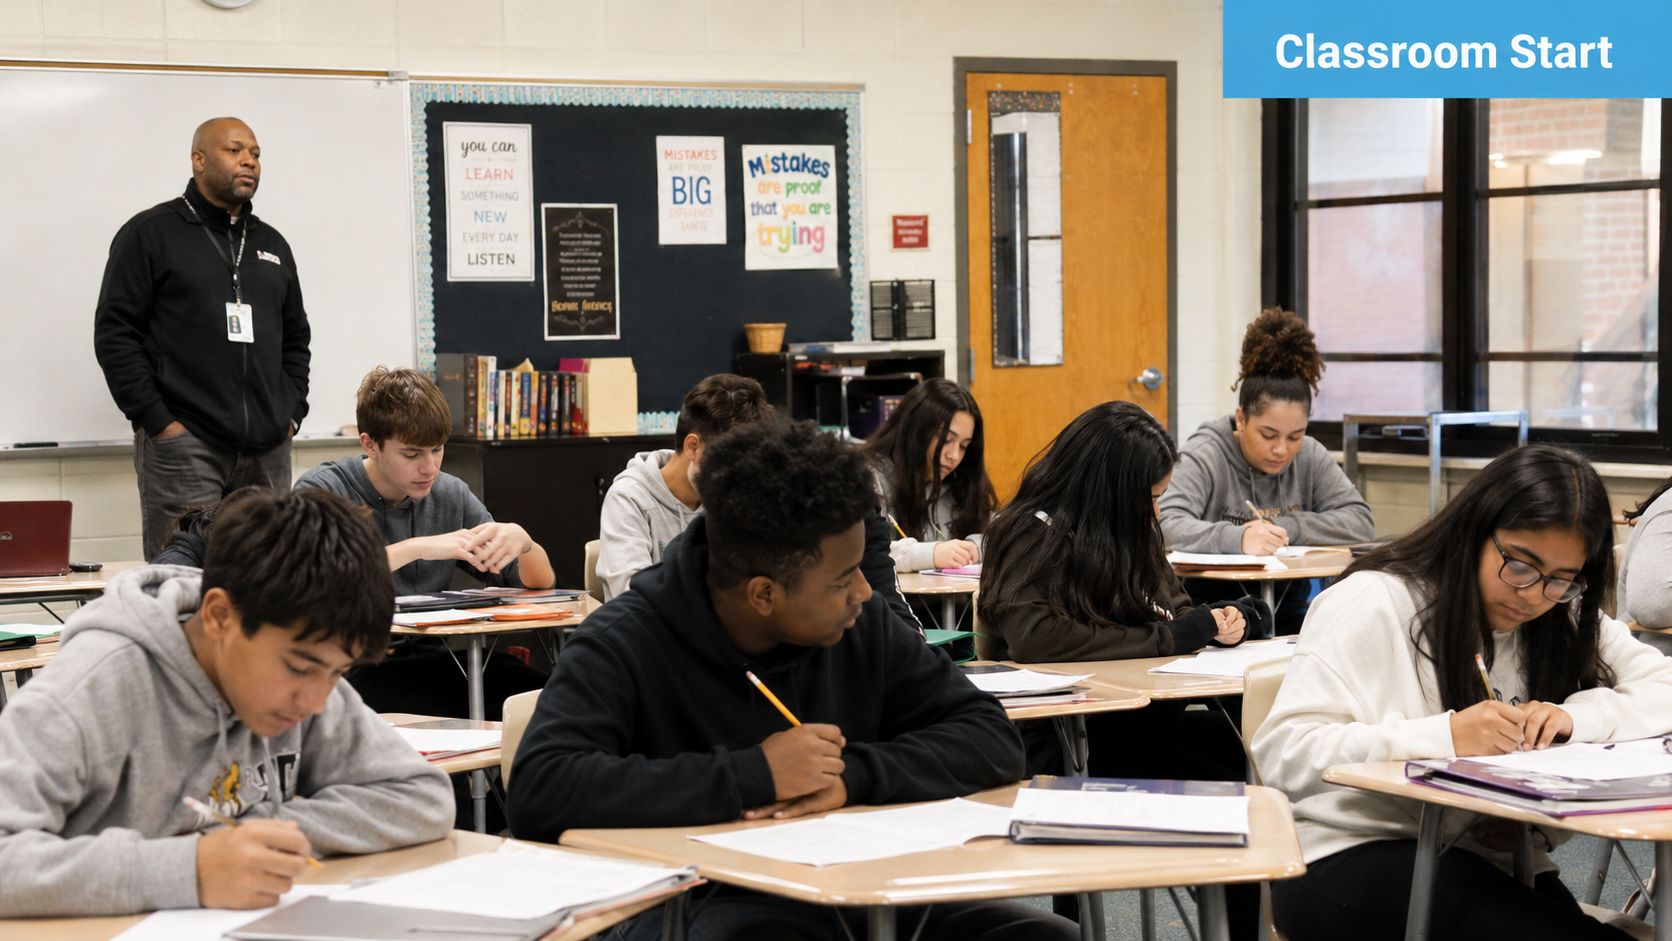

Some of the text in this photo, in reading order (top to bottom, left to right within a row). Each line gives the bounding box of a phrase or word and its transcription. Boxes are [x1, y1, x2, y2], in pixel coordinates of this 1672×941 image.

[461, 140, 517, 158] you can
[664, 149, 717, 161] MISTAKES
[748, 152, 830, 178] Mistakes
[465, 167, 514, 180] LEARN
[461, 190, 519, 201] SOMETHING
[672, 175, 712, 205] BIG
[757, 180, 822, 197] are proof
[474, 210, 508, 223] NEW
[750, 201, 831, 220] that you are
[462, 231, 519, 243] EVERY DAY
[757, 221, 826, 253] trying
[467, 253, 515, 265] LISTEN
